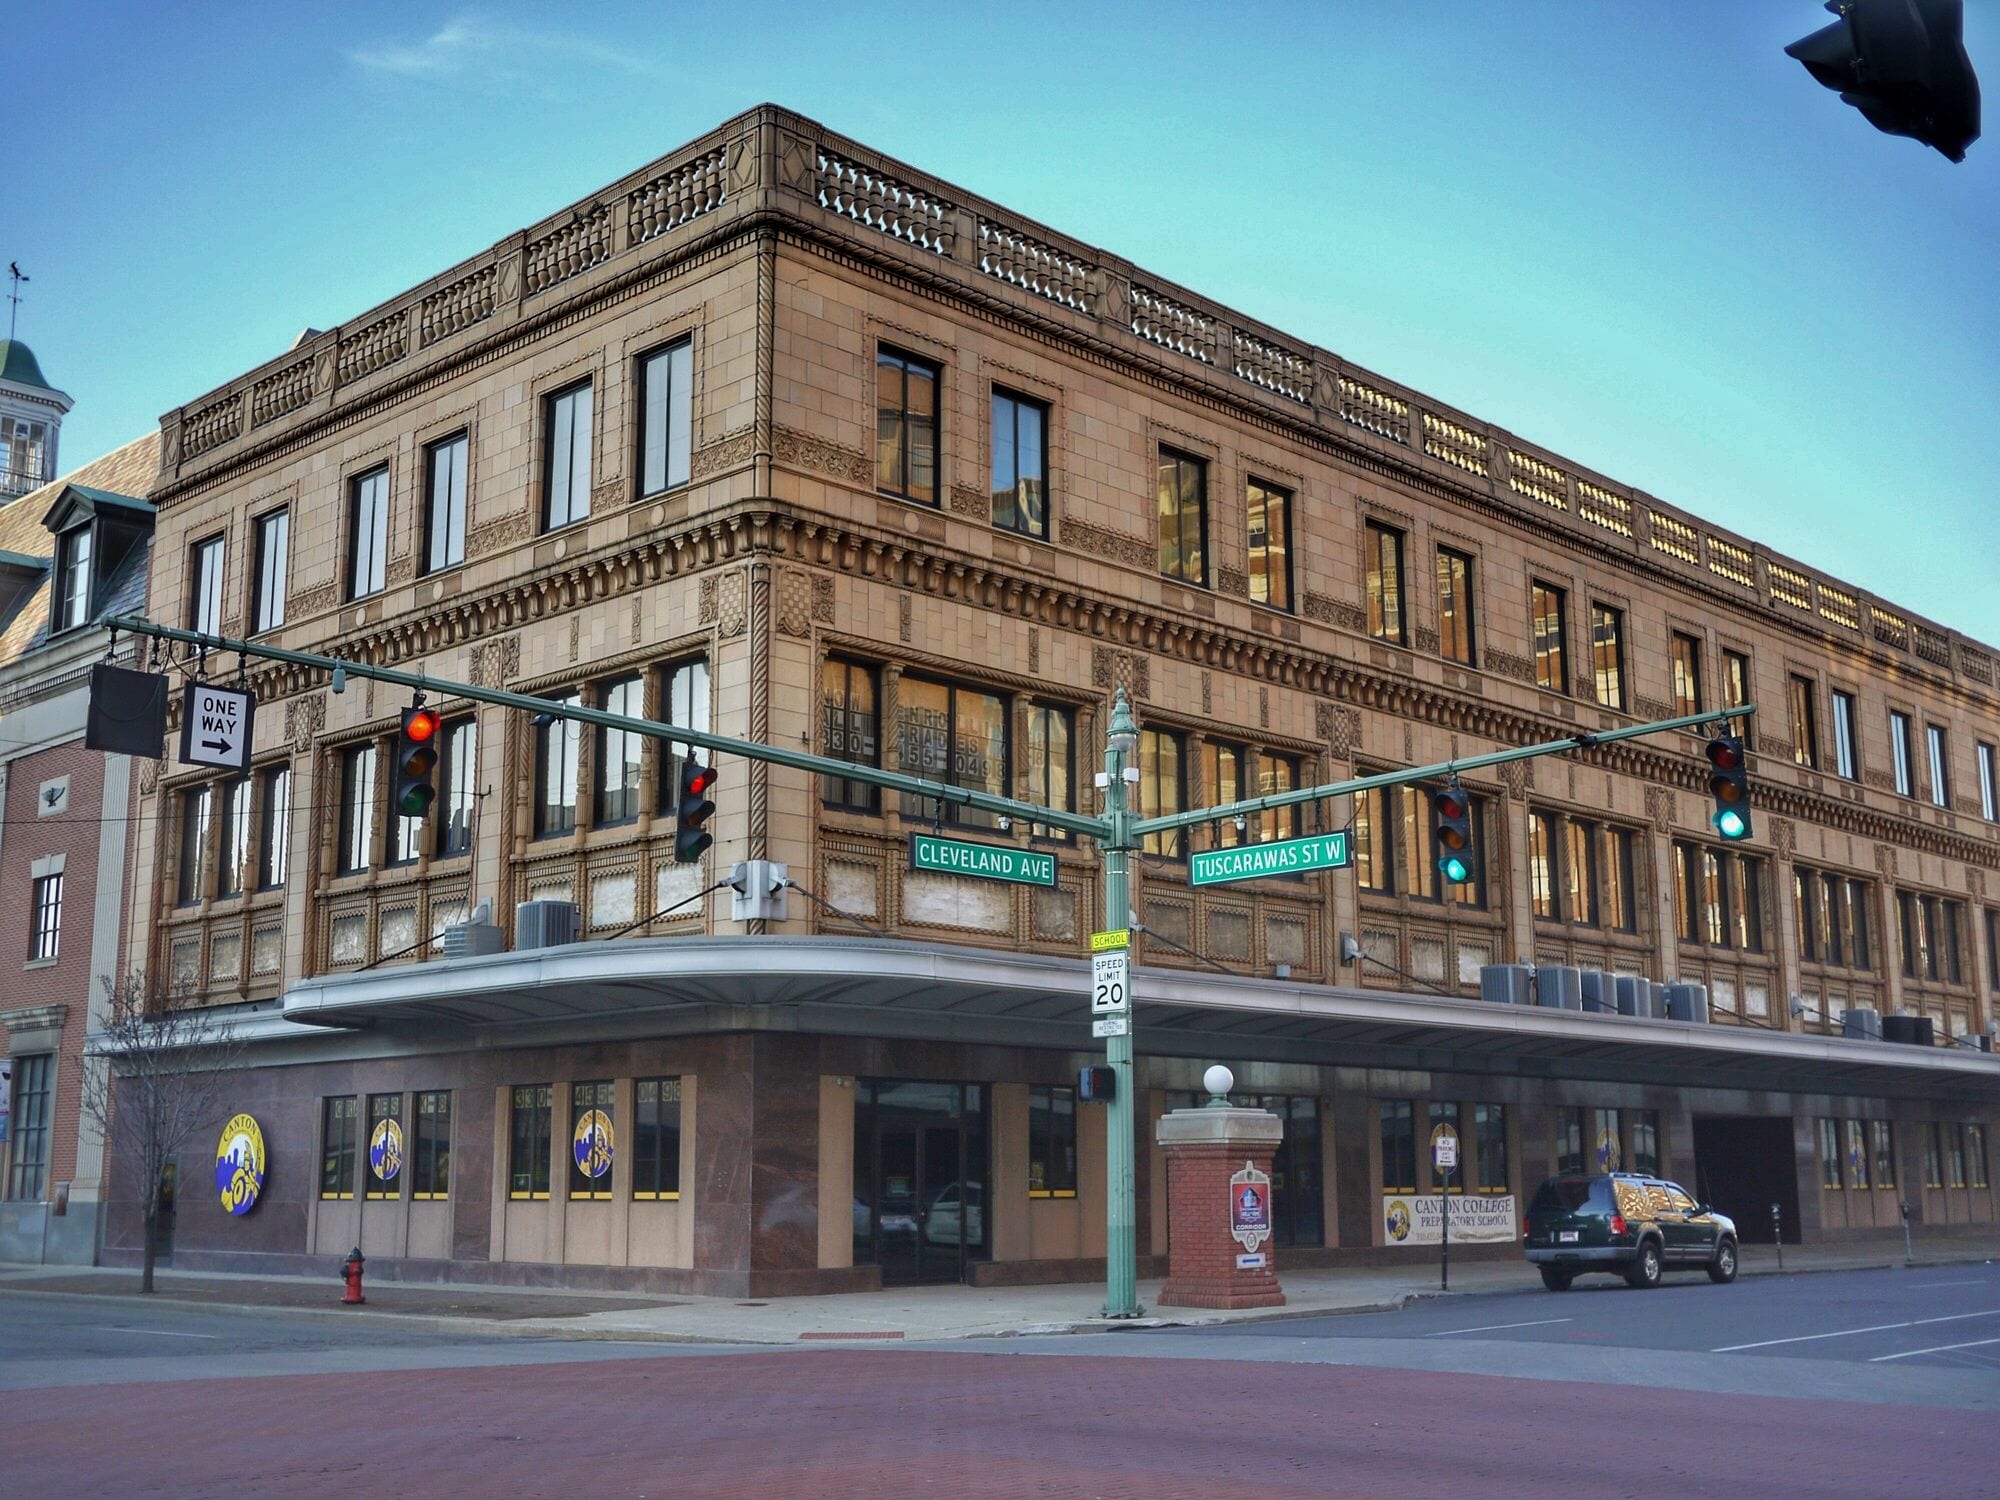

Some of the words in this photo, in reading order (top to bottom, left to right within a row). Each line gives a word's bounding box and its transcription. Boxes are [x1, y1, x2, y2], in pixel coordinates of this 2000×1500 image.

[203, 697, 237, 716] ONE
[202, 715, 237, 735] WAY
[919, 843, 1013, 874] CLEVELAND
[1020, 858, 1050, 879] AVE
[1197, 846, 1297, 878] TUSCARAWAS
[1302, 843, 1320, 864] ST
[1325, 840, 1341, 860] W
[1094, 933, 1125, 947] SCHOOL
[1095, 958, 1124, 971] SPEED
[1098, 971, 1120, 982] LIMIT
[1096, 983, 1123, 1006] 20
[223, 1115, 258, 1142] CANTON
[375, 1121, 398, 1138] CANON
[579, 1111, 607, 1131] CANON
[1463, 1199, 1512, 1213] COLLEGE
[1236, 1223, 1267, 1231] CORRIDOR
[1421, 1216, 1477, 1227] PREPRATORY
[1477, 1215, 1509, 1226] SCHOOL
